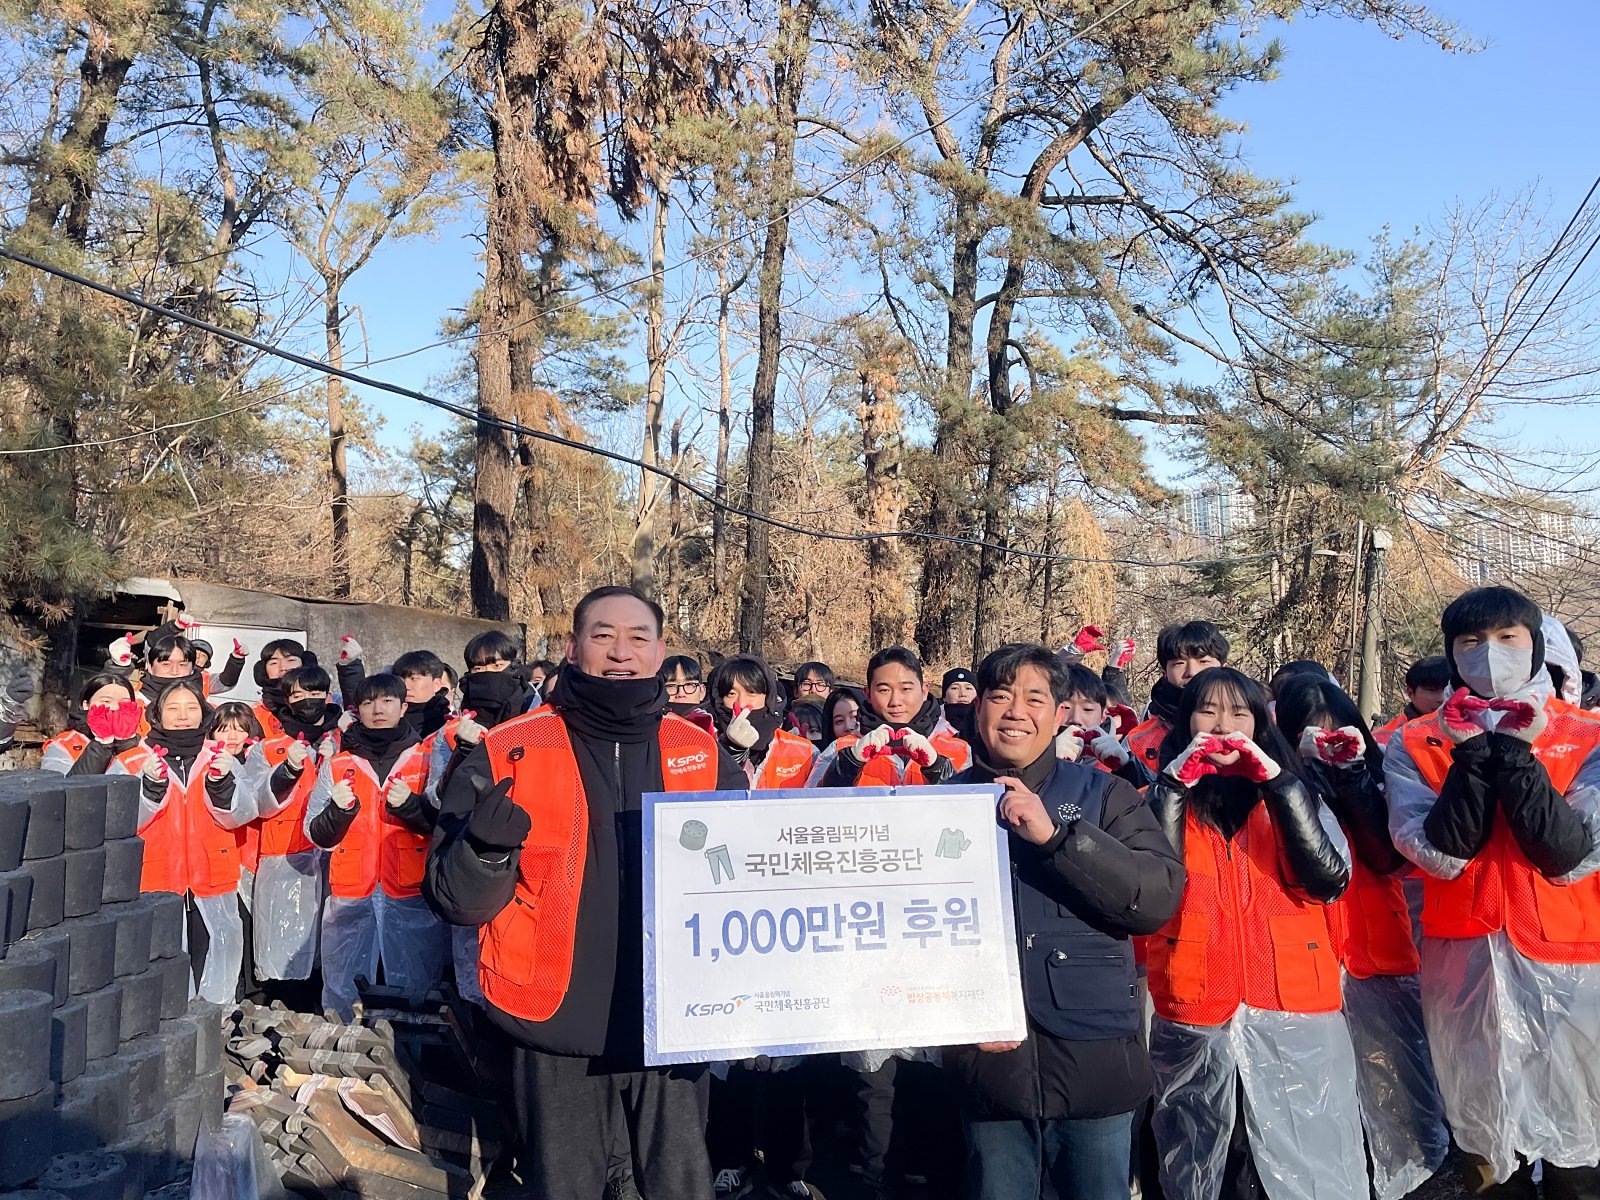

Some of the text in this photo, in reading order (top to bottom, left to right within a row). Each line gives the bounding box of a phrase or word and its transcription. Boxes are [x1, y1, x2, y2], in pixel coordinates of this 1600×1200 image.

[667, 753, 705, 768] KSPO
[777, 824, 890, 845] 서울올림픽기념
[744, 847, 924, 877] 국민체육진흥공단
[684, 897, 982, 962] 1,000만원 후원
[685, 1002, 735, 1017] KSPO
[754, 997, 831, 1013] 국민체육진흥공단
